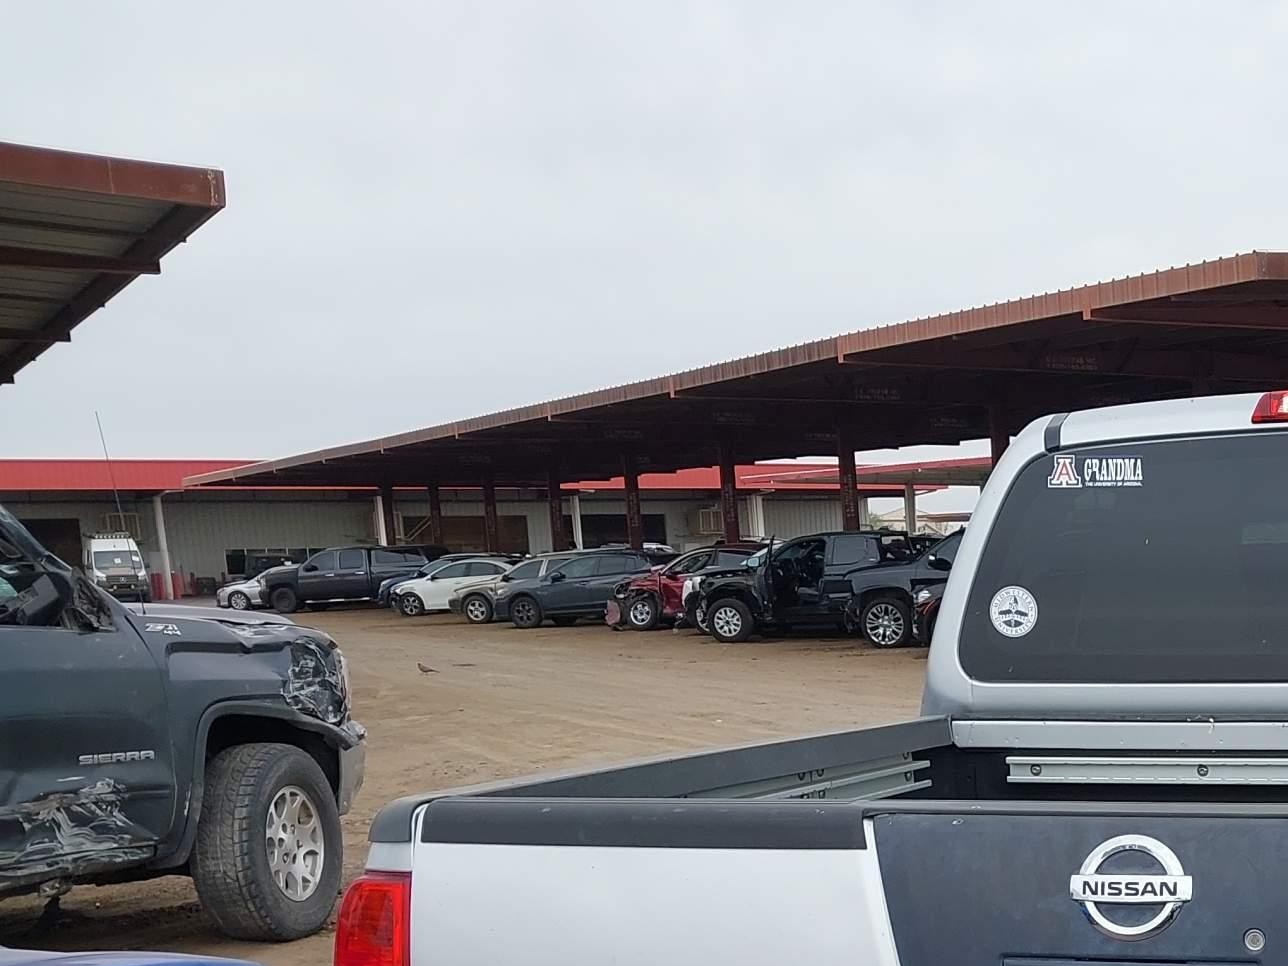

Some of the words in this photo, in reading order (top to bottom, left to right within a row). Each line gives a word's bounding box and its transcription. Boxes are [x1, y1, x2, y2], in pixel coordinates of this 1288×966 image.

[1084, 458, 1143, 480] GRANDMA
[78, 750, 155, 765] SIERRA
[1082, 880, 1178, 897] NISSAN
